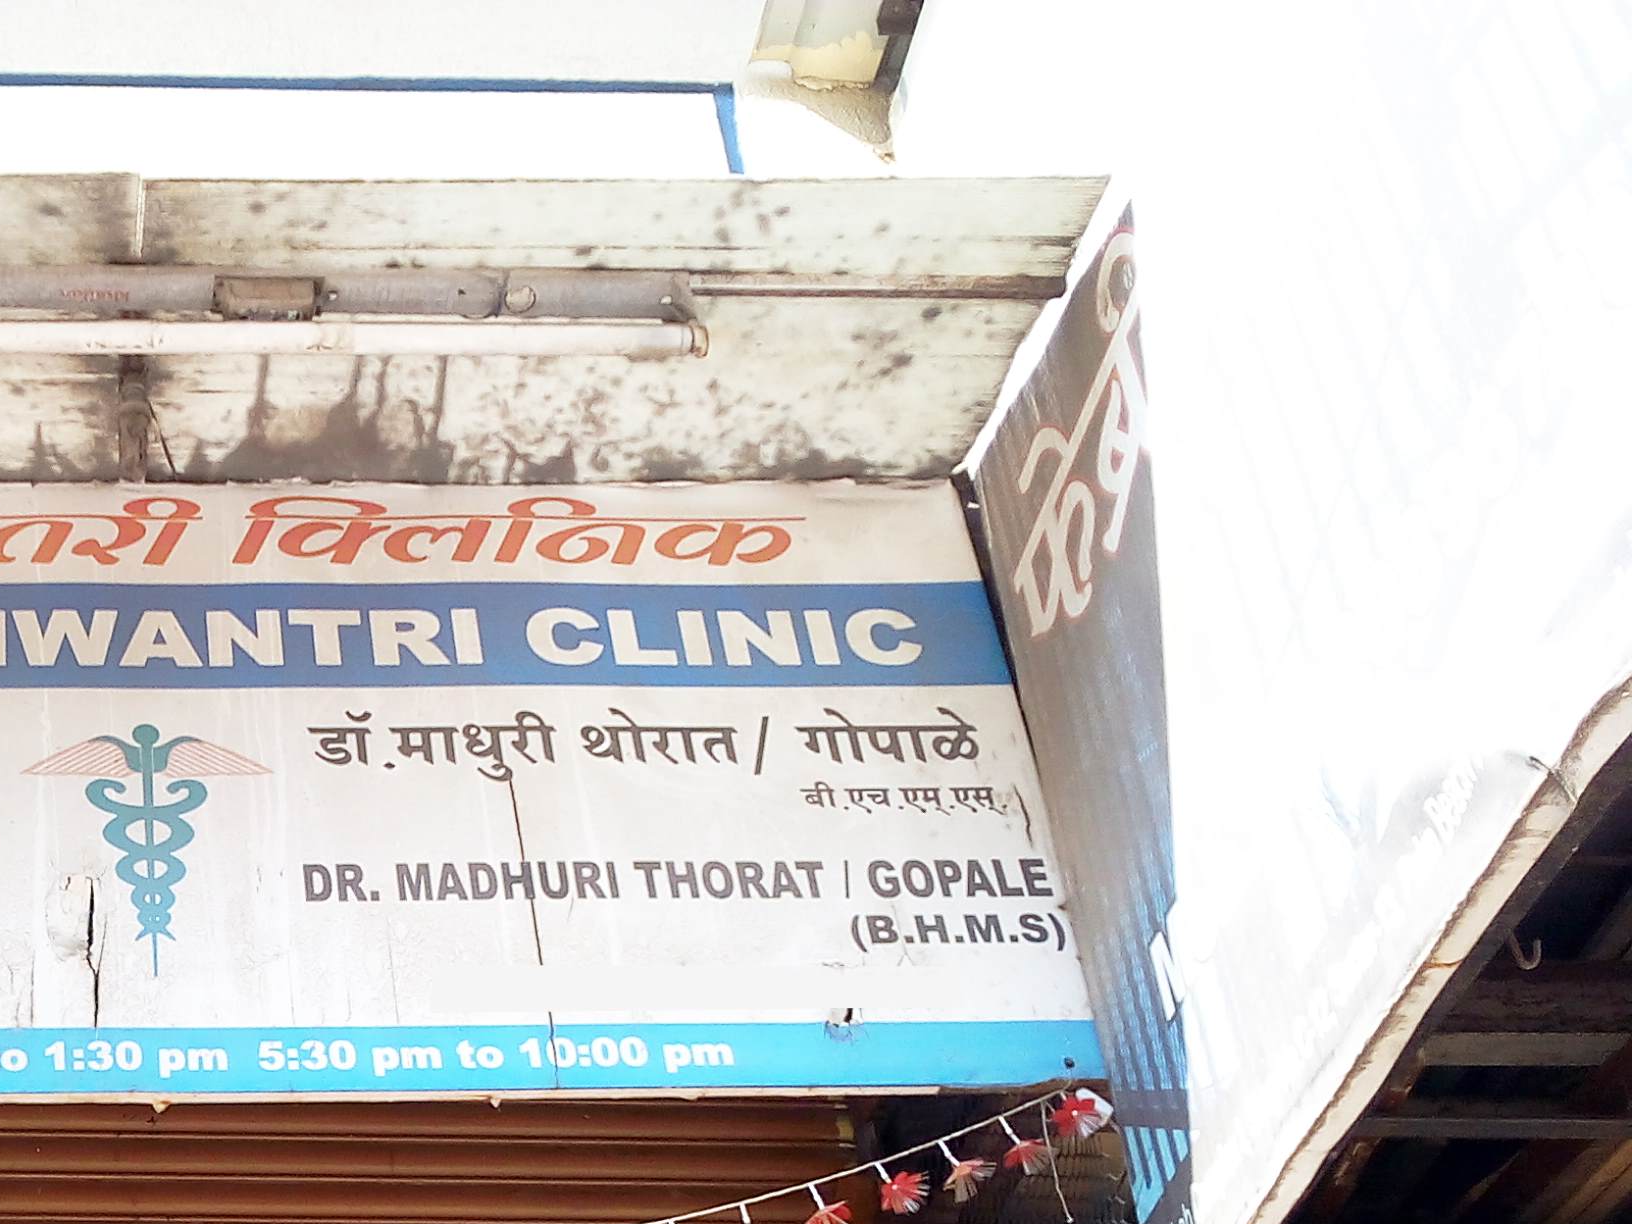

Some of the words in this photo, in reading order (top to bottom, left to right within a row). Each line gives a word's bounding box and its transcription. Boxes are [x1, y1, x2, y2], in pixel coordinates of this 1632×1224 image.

[524, 607, 924, 667] CLINIC
[794, 706, 980, 765] गोपाळे
[301, 862, 381, 903] DR.
[395, 861, 622, 901] MADHURI
[632, 860, 825, 900] THORAT
[868, 858, 1057, 898] GOPALE
[851, 913, 1068, 951] (B.H.M.S)
[43, 1040, 144, 1072] 1:30
[158, 1046, 229, 1078] pm
[257, 1040, 357, 1071] 5:30
[372, 1045, 443, 1077] pm
[456, 1041, 505, 1070] to
[518, 1036, 649, 1069] 10:00
[663, 1041, 737, 1074] pm
